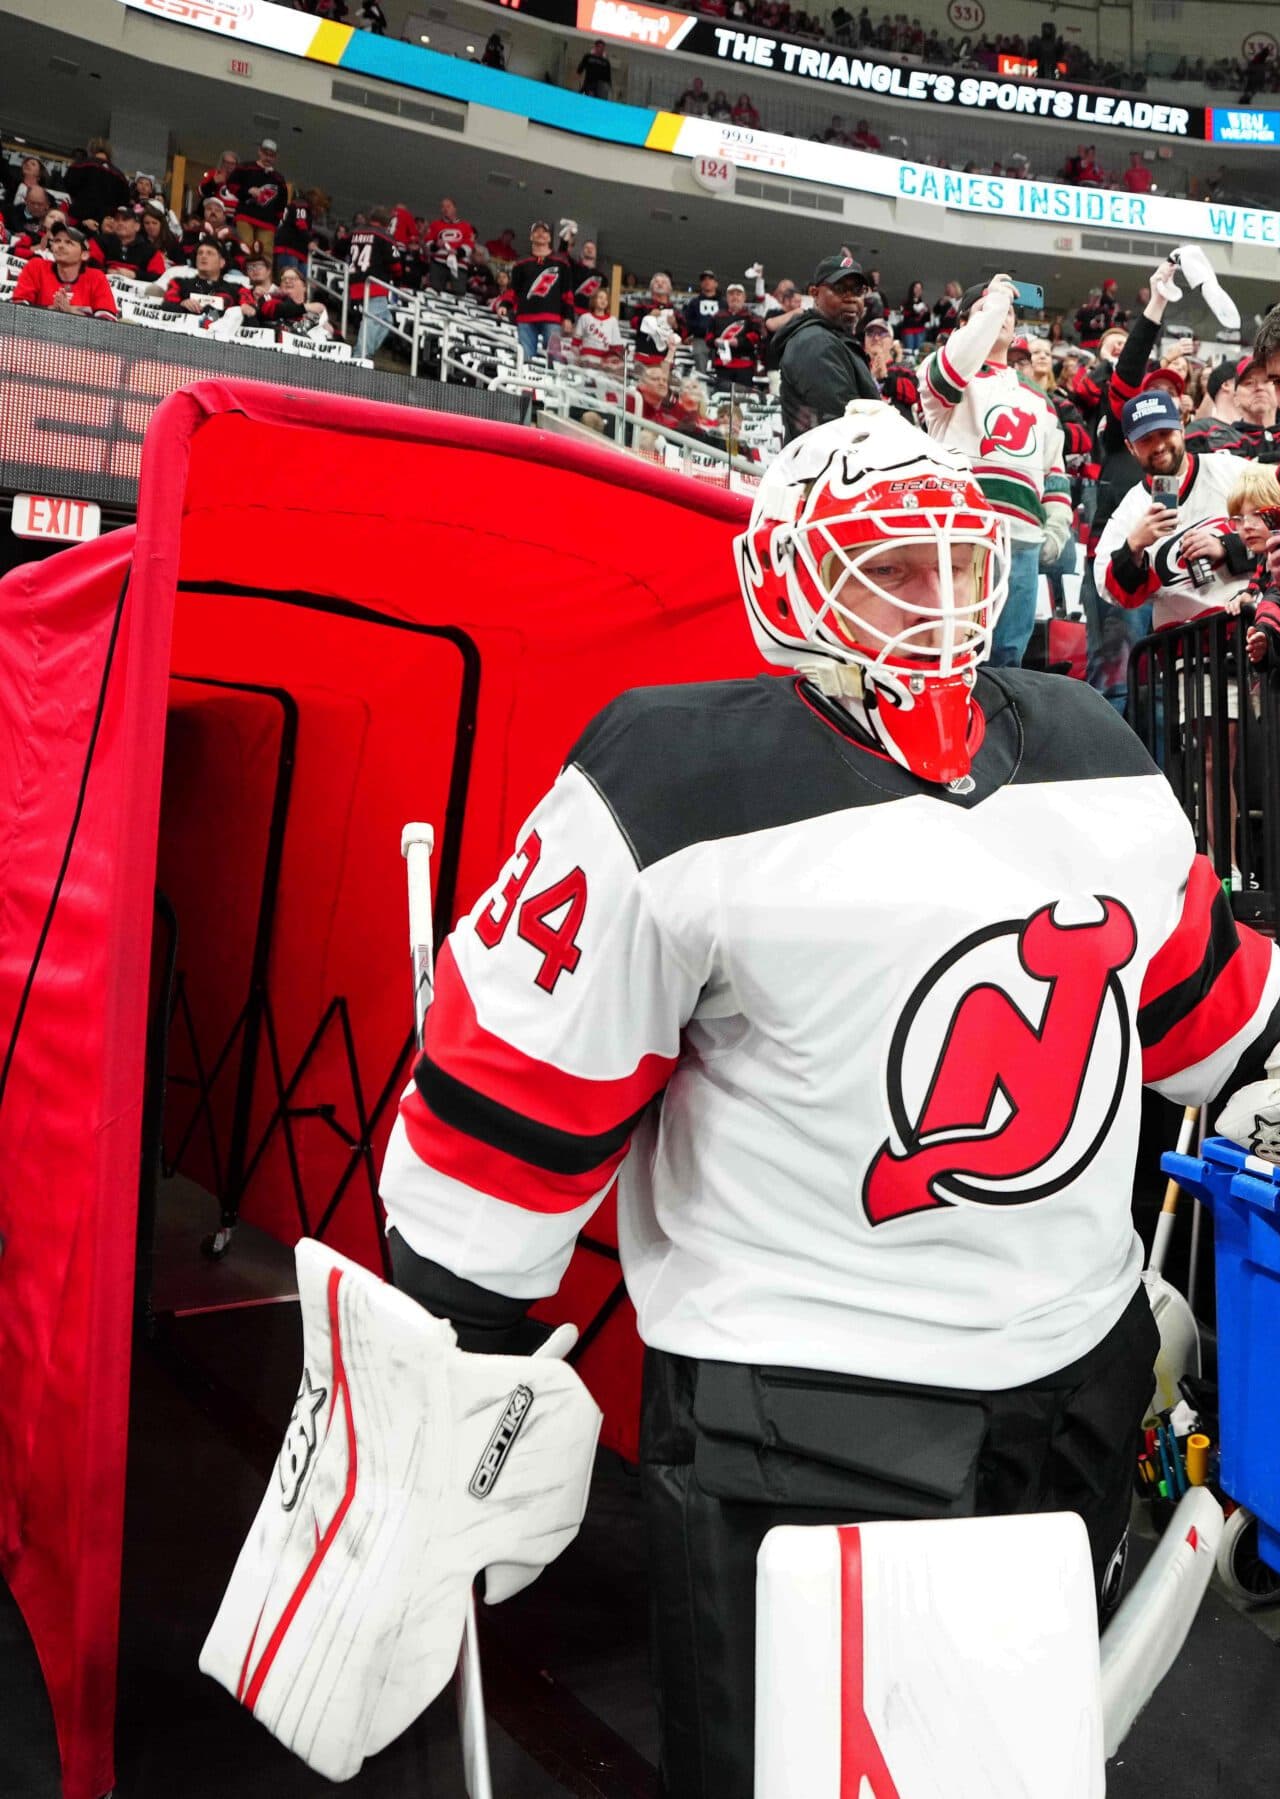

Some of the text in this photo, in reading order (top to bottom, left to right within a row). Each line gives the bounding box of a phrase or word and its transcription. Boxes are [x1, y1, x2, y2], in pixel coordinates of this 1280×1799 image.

[954, 6, 979, 21] 331
[231, 59, 249, 76] EXIT
[714, 28, 1189, 134] THE TRIANGLE'S SPORTS LEADER
[721, 128, 755, 145] 99.9
[700, 159, 728, 180] 124
[899, 166, 1004, 209] CANES
[1019, 185, 1146, 226] INSIDER
[350, 244, 372, 272] 24
[27, 495, 89, 537] EXIT
[474, 828, 588, 996] 34
